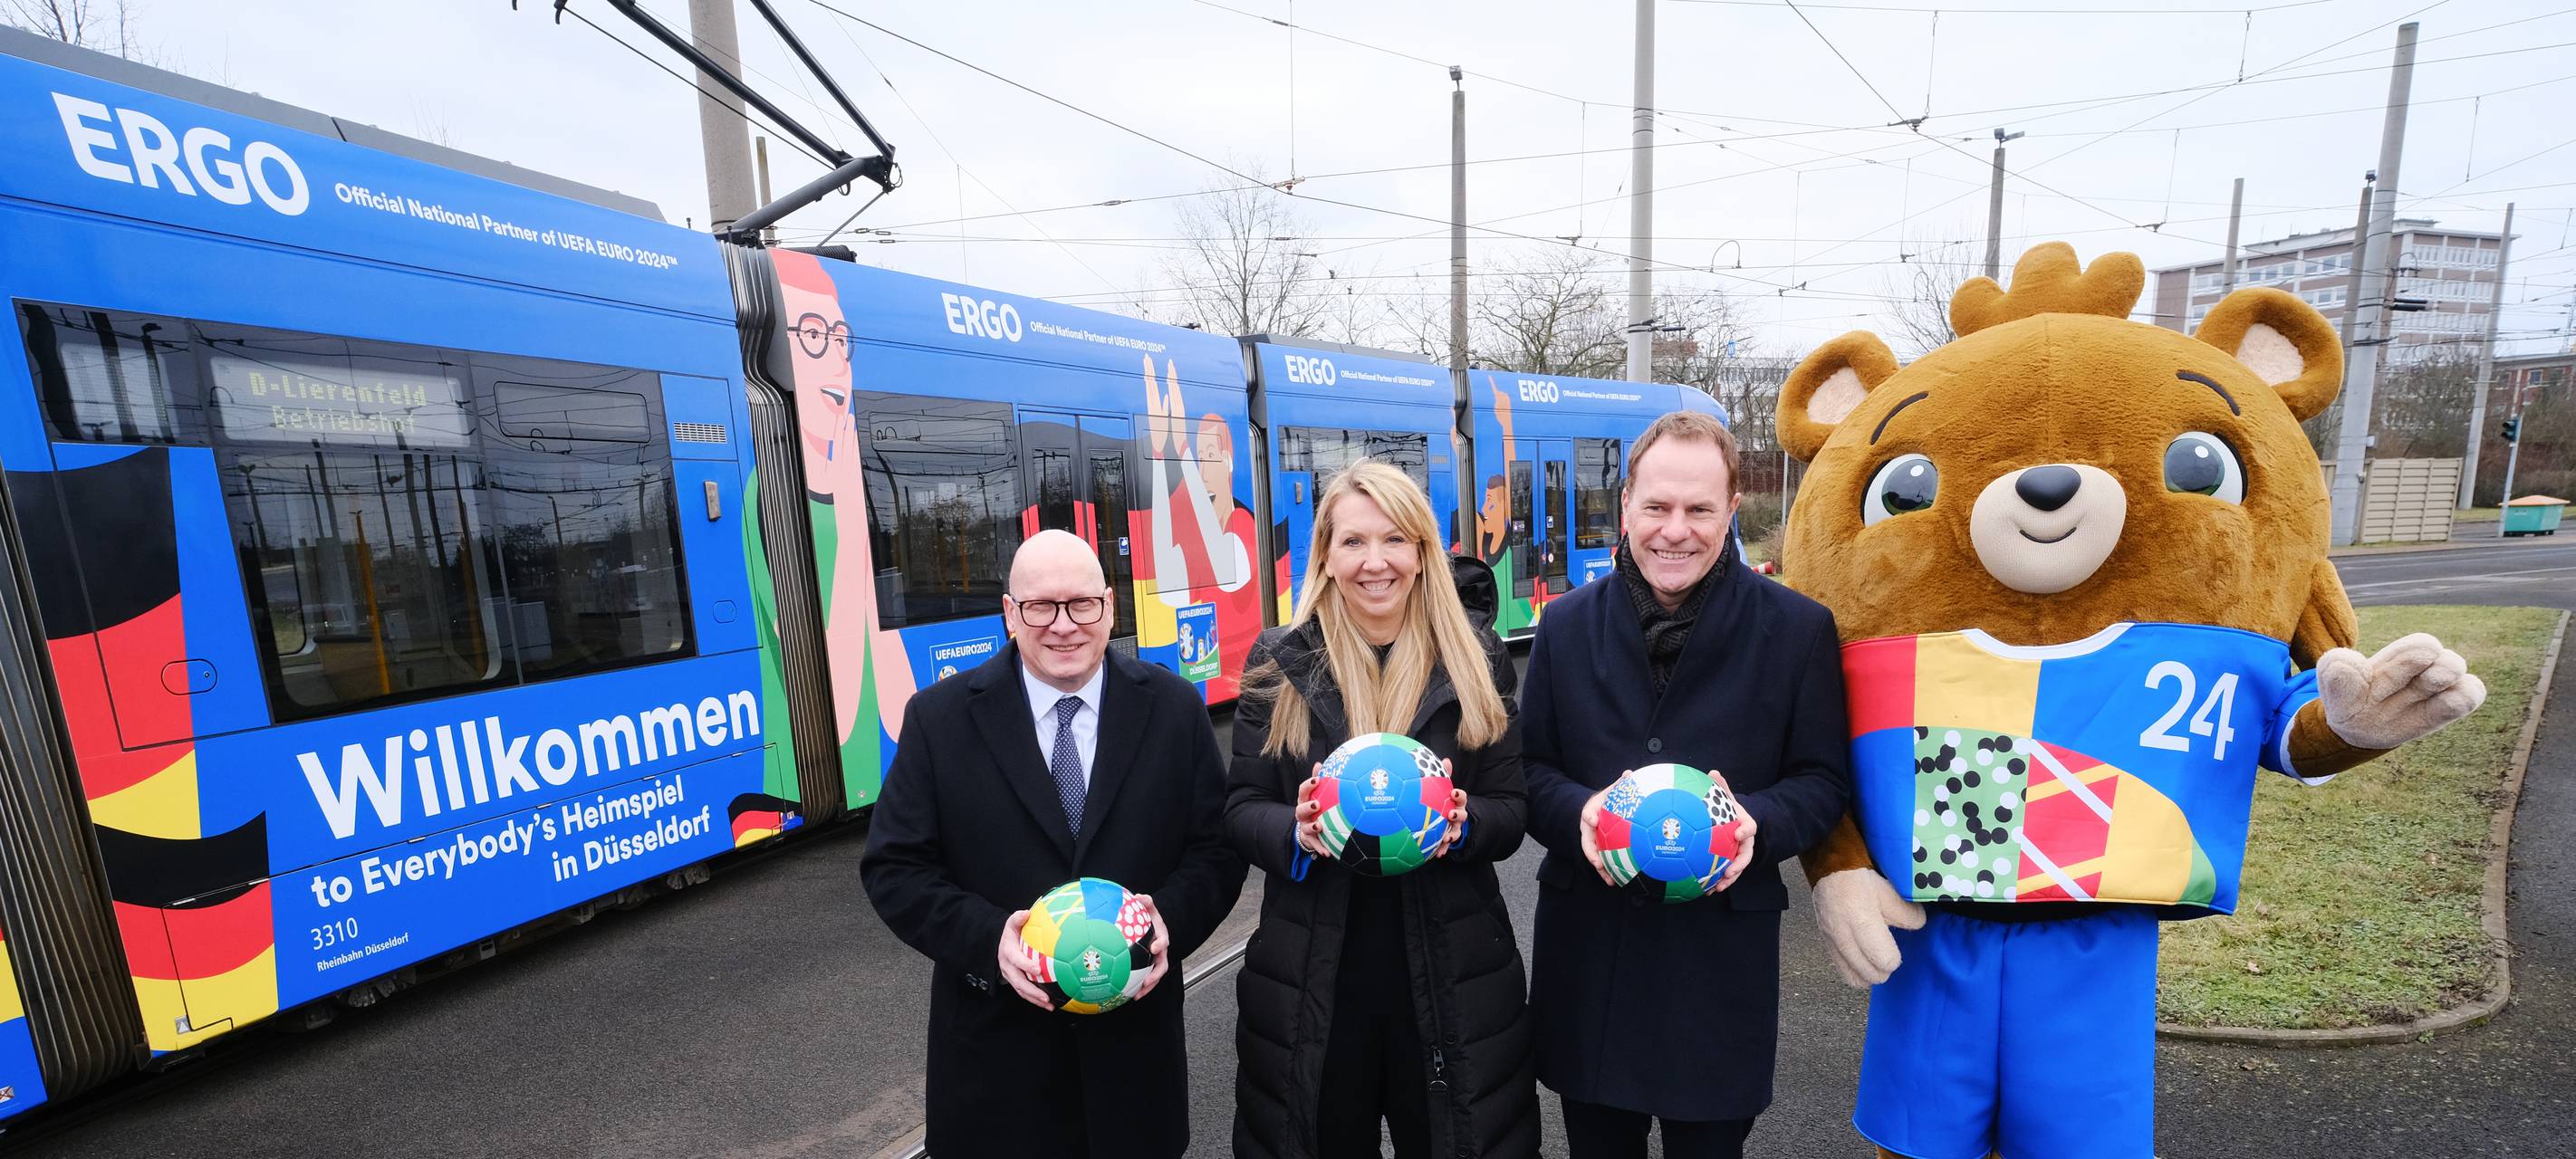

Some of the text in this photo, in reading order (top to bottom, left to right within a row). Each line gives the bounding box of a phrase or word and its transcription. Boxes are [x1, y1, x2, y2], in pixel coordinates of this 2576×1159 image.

[51, 91, 310, 216] ERGO
[334, 182, 405, 216] Official
[407, 197, 481, 231] National
[482, 215, 538, 244] Partner
[541, 228, 557, 245] of
[557, 231, 595, 255] UEFA
[596, 240, 634, 263] EURO
[941, 292, 1023, 343] ERGO
[1030, 321, 1056, 336] Official
[1056, 325, 1084, 340] National
[1084, 330, 1107, 344] Partner
[1107, 335, 1114, 345] of
[1113, 336, 1130, 349] UEFA
[1130, 340, 1147, 350] EURO
[248, 370, 427, 407] D-Lierenfeld
[1284, 354, 1336, 387] ERGO
[1518, 379, 1559, 404] ERGO
[272, 404, 415, 434] Betriebshof
[2139, 660, 2240, 761] 24
[296, 690, 761, 840] Willkommen
[311, 874, 353, 908] to
[562, 775, 684, 836] Heimspiel
[551, 804, 711, 883] in Düsseldorf
[310, 916, 359, 951] 3310
[317, 932, 409, 972] Rheinbahn Düsseldorf
